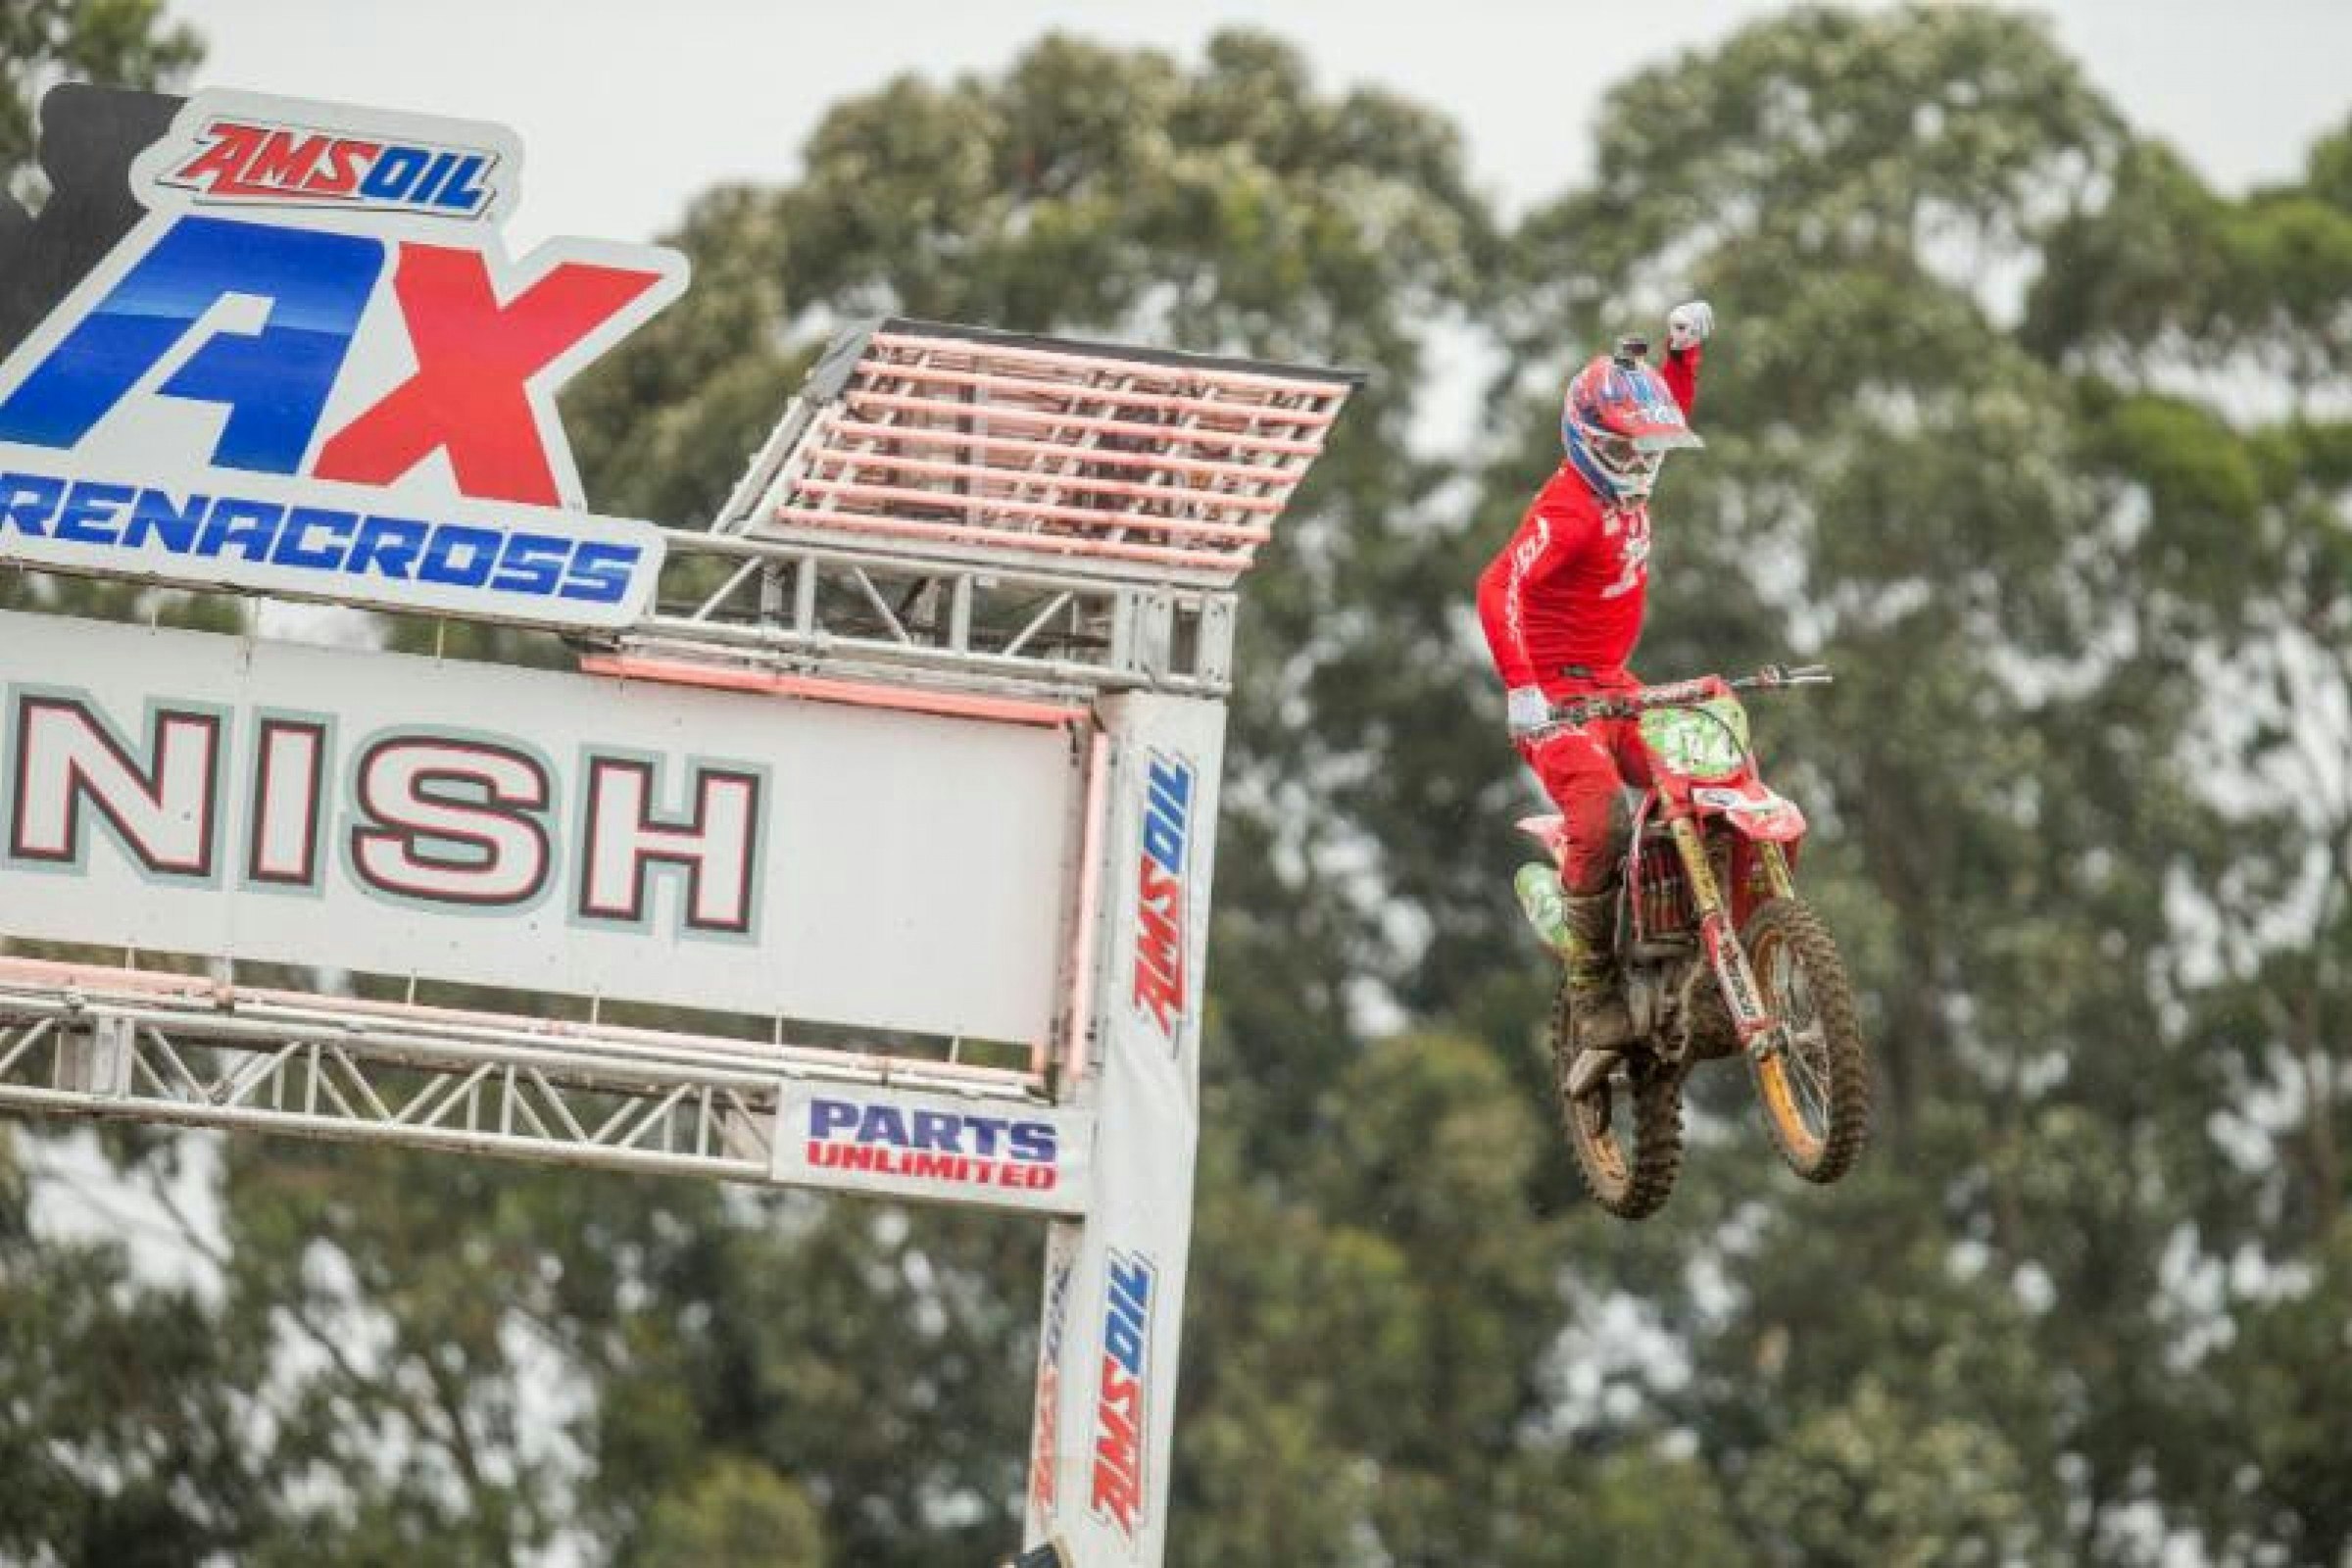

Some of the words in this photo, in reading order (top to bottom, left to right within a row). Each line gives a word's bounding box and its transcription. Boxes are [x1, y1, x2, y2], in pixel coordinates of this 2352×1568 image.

[174, 120, 488, 211] AMSOIL
[0, 214, 666, 509] AX
[0, 470, 642, 605] RENACROSS
[6, 688, 766, 939] NISH
[1133, 759, 1191, 1038] AMSOIL
[806, 1140, 1058, 1190] UNLIMITED
[808, 1098, 1058, 1163] PARTS
[1091, 1261, 1150, 1531] AMSOIL
